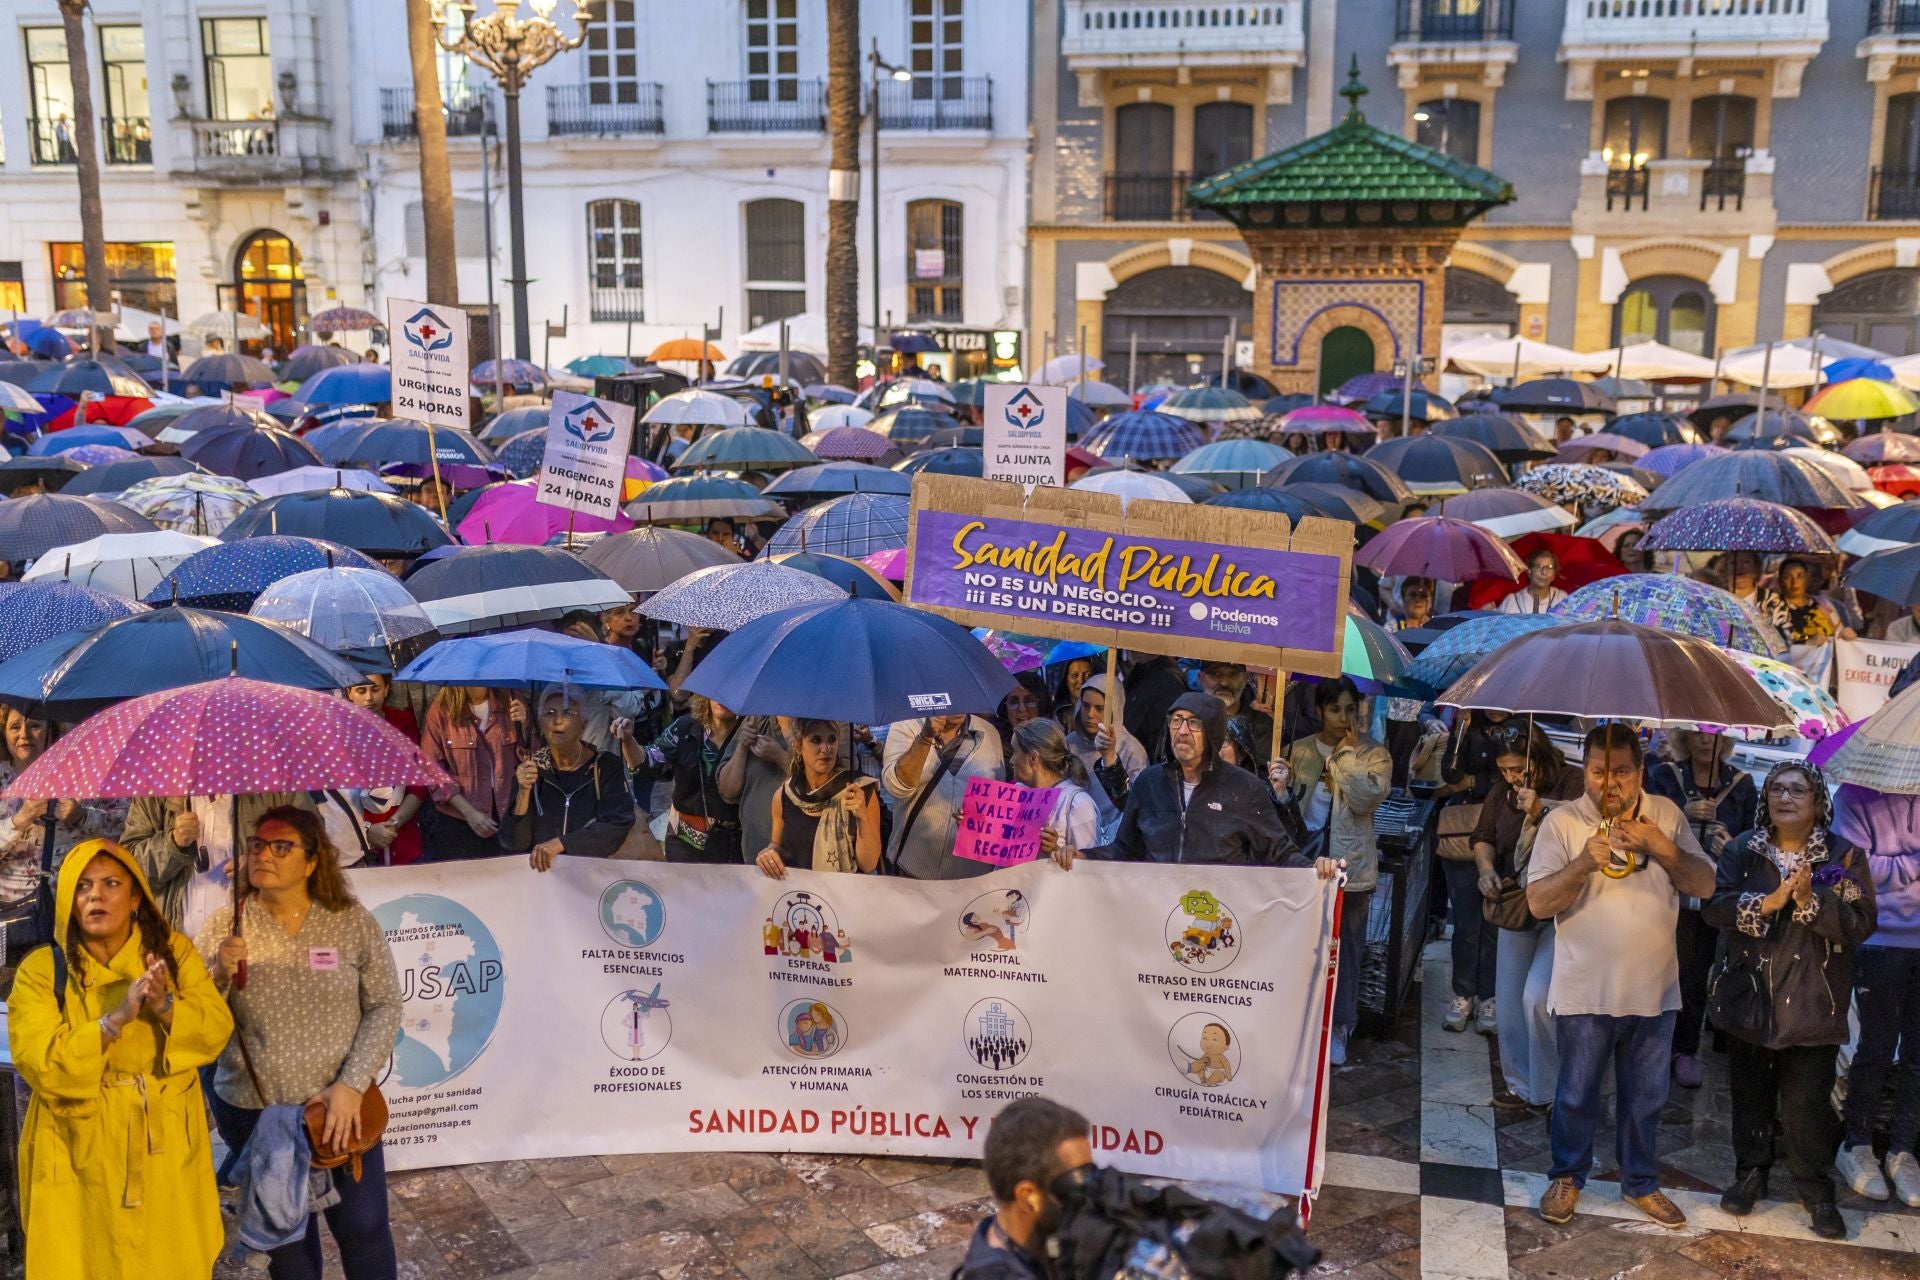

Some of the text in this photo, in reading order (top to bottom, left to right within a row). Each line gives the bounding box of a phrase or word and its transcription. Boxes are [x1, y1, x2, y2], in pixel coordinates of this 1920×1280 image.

[398, 377, 462, 397] URGENCIAS
[399, 396, 463, 417] 24 HORAS
[1008, 430, 1042, 438] SALUDYVIDA
[436, 452, 465, 460] OSMOS
[996, 454, 1051, 465] LA JUNTA
[548, 465, 615, 489] URGENCIAS
[544, 483, 612, 508] 24 HORAS
[952, 521, 1276, 599] Sanidad Pública
[965, 572, 1175, 611] NO ES UN NEGOCIO...
[990, 592, 1013, 607] ES
[1018, 596, 1047, 611] UN
[1052, 600, 1146, 624] DERECHO
[1151, 613, 1171, 627] !!!
[1211, 607, 1279, 626] Podemos
[1210, 620, 1251, 634] Huelva
[1866, 654, 1879, 667] EL
[1845, 669, 1873, 684] EXIGE
[1875, 673, 1881, 685] A
[970, 782, 1035, 804] MI VIDA
[975, 801, 1014, 820] VALE
[974, 839, 1036, 859] RECORTES
[399, 926, 428, 935] UNIDOS
[446, 922, 463, 930] UNA
[431, 929, 465, 939] CALIDAD
[582, 949, 685, 963] FALTA DE SERVICIOS
[970, 953, 1021, 965] HOSPITAL
[603, 964, 663, 976] ESENCIALES
[788, 959, 831, 972] ESPERAS
[769, 971, 853, 987] INTERMINABLES
[944, 968, 1048, 983] MATERNO-INFANTIL
[1138, 973, 1274, 992] RETRASO EN URGENCIAS
[1163, 991, 1252, 1007] Y EMERGENCIAS
[609, 1066, 666, 1077] ÉXODO DE
[762, 1064, 873, 1077] ATENCIÓN PRIMARIA
[593, 1081, 682, 1093] PROFESIONALES
[790, 1081, 849, 1091] Y HUMANA
[956, 1074, 1044, 1086] CONGESTIÓN DE
[389, 1087, 482, 1105] lucha por su sanidad
[961, 1089, 1040, 1100] LOS SERVICIOS
[1155, 1086, 1267, 1109] CIRUGÍA TORÁCICA Y
[1179, 1105, 1243, 1122] PEDIÁTRICA
[689, 1105, 1164, 1155] SANIDAD PÚBLICA Y IDAD
[400, 1137, 411, 1145] 07
[413, 1136, 424, 1144] 35
[427, 1134, 438, 1143] 79
